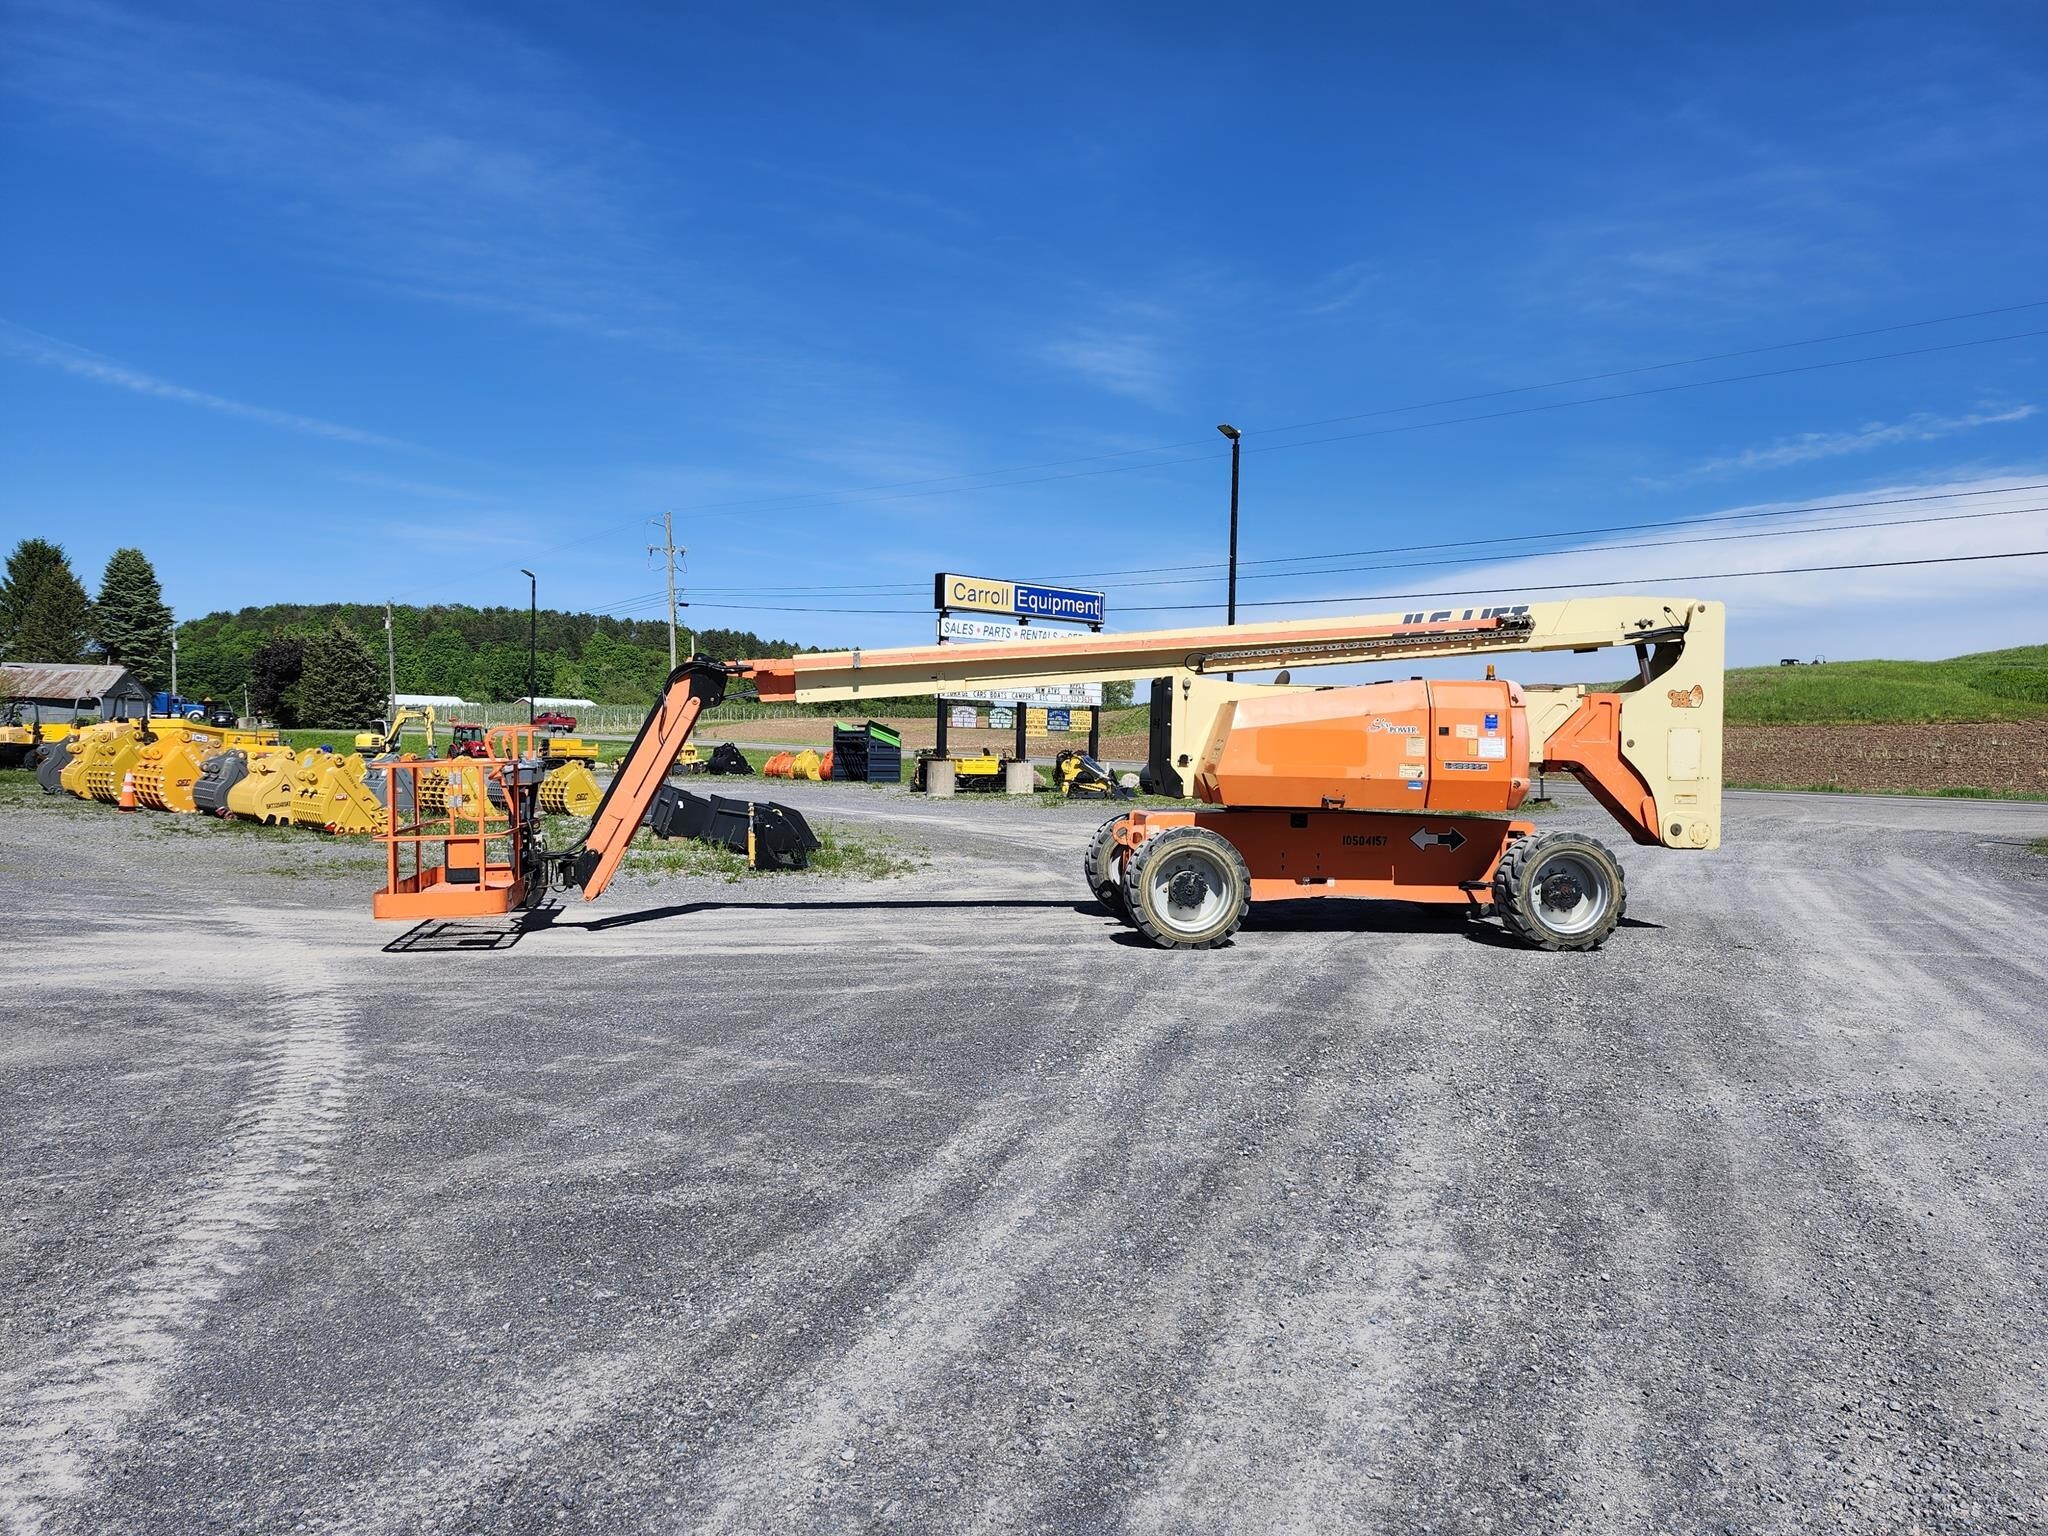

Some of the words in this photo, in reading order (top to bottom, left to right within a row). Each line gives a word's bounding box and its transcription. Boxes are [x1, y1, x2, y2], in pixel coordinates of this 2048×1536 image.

[953, 582, 1009, 606] Carroll
[1017, 589, 1099, 615] Equipment
[943, 621, 974, 635] SALES
[983, 625, 1011, 639] PARTS
[1019, 629, 1058, 641] RENTALS
[1390, 726, 1417, 734] POWER
[1342, 835, 1388, 846] 10504157
